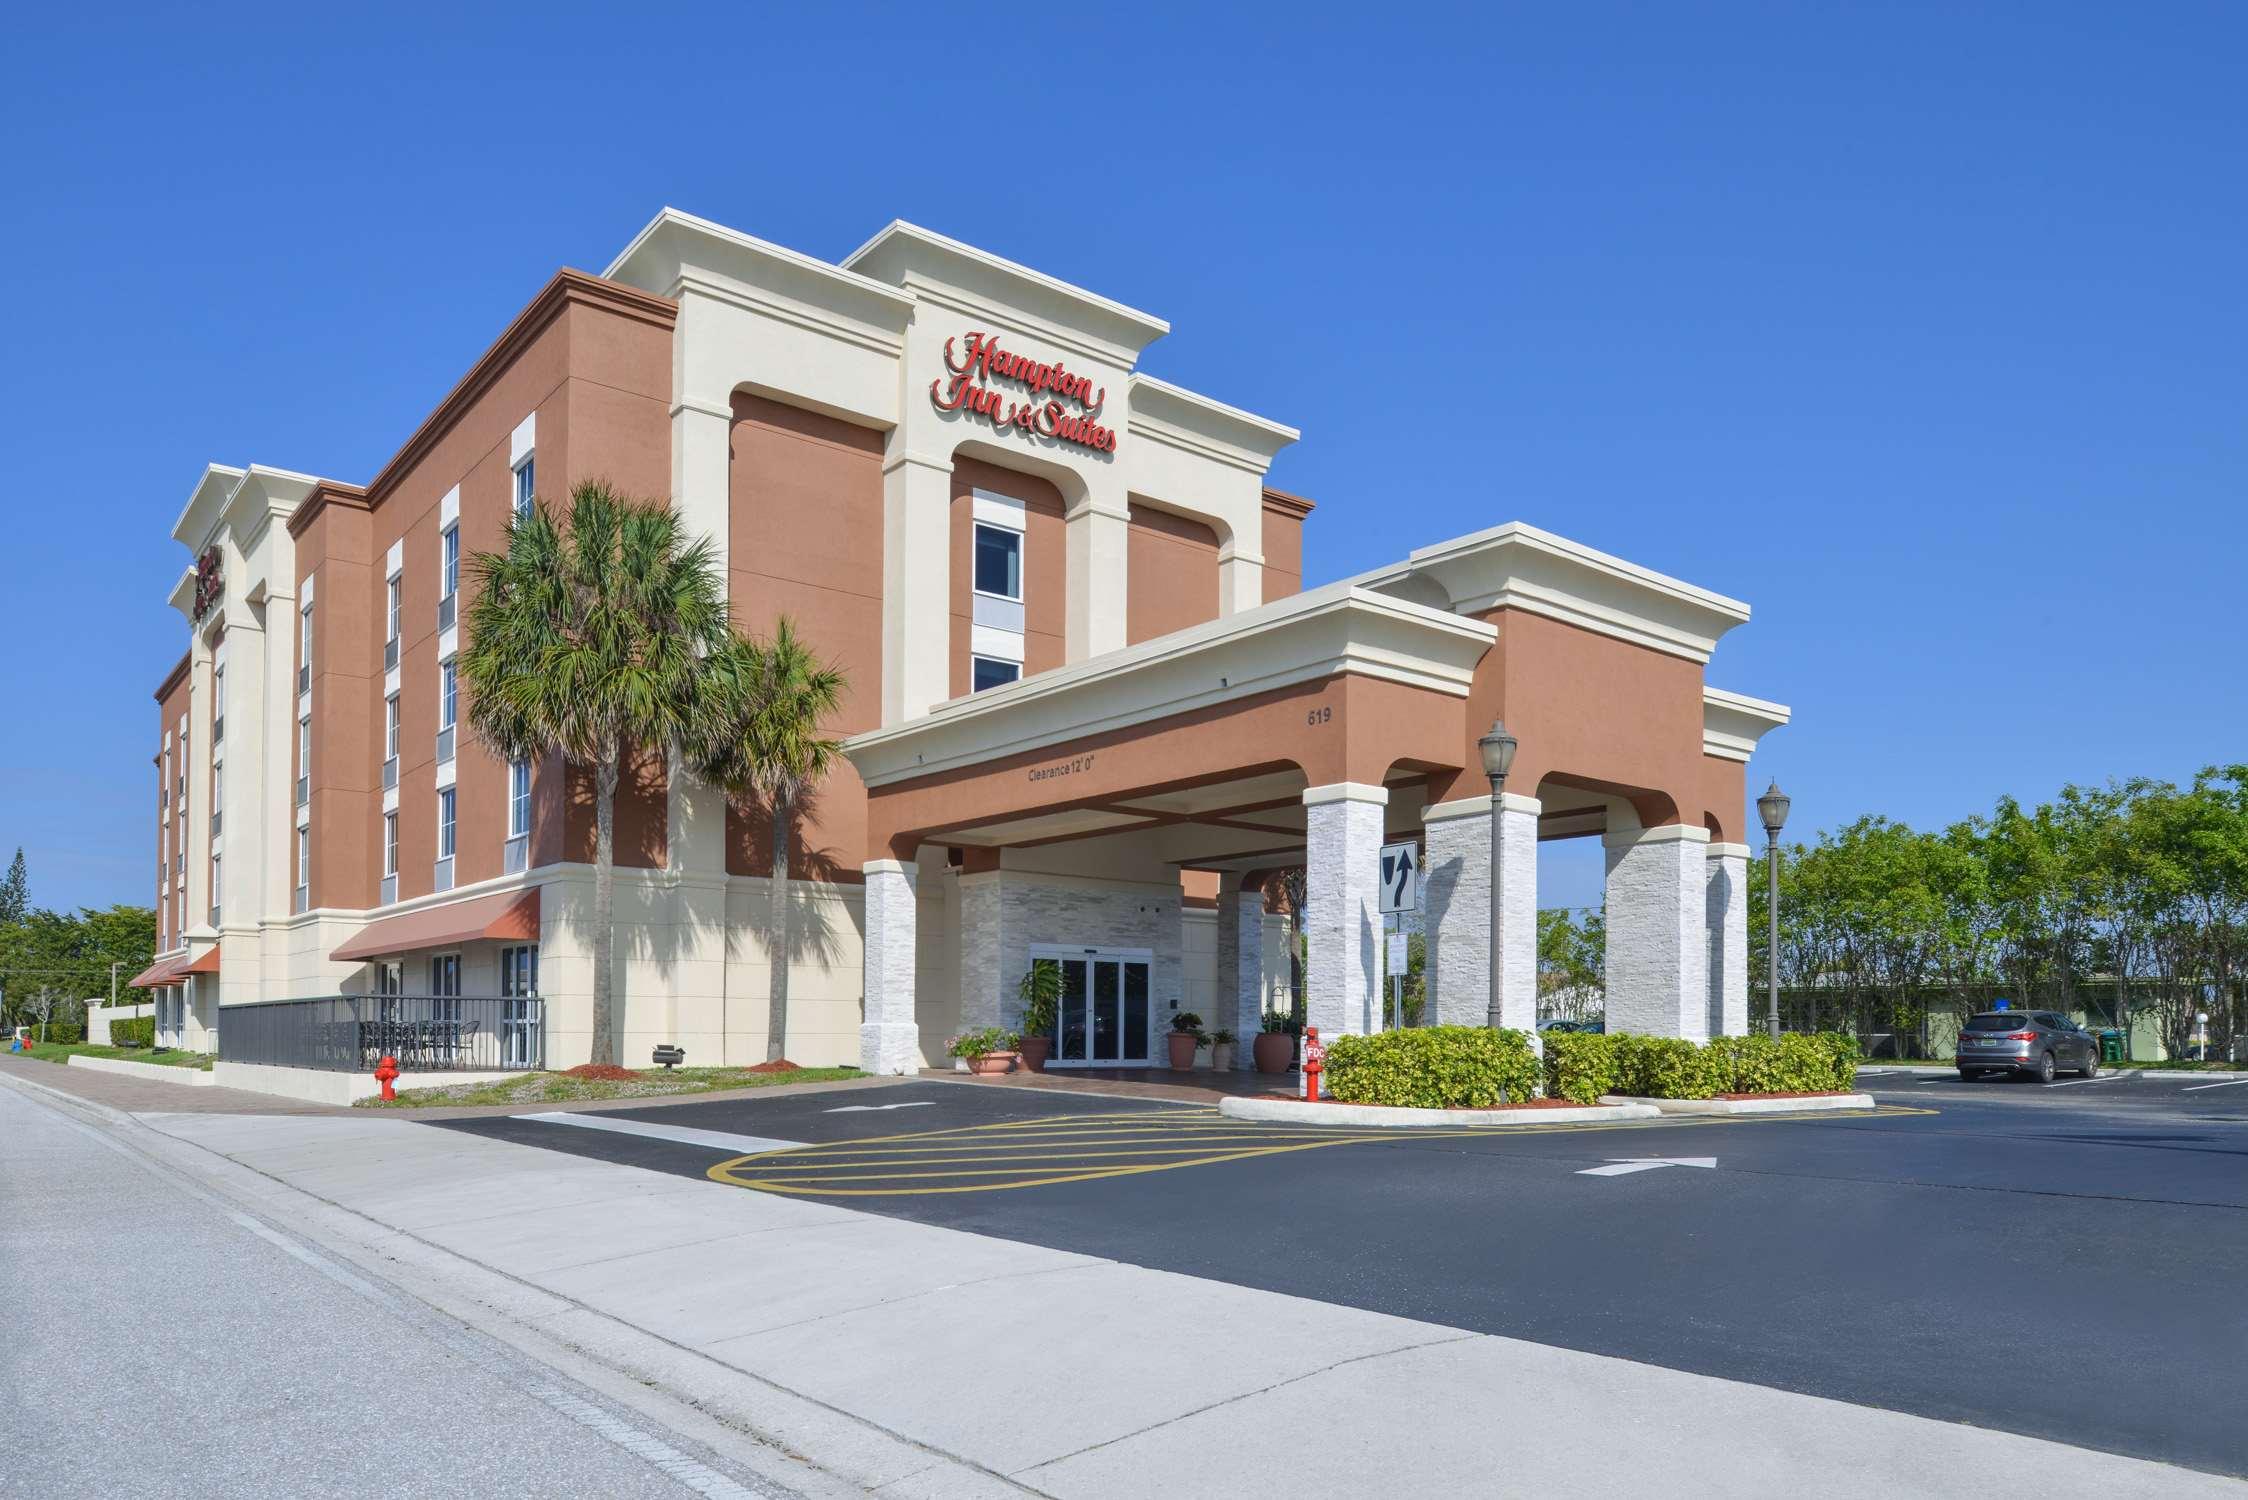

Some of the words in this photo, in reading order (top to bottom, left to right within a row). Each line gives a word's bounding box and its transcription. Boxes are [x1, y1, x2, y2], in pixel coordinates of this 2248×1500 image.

[944, 331, 1105, 410] Hampton
[930, 373, 1017, 426] Inn
[1016, 403, 1035, 434] &
[1034, 400, 1117, 453] Suites
[1308, 706, 1331, 726] 619
[1028, 765, 1070, 782] Clearance
[1307, 1047, 1326, 1058] FDC
